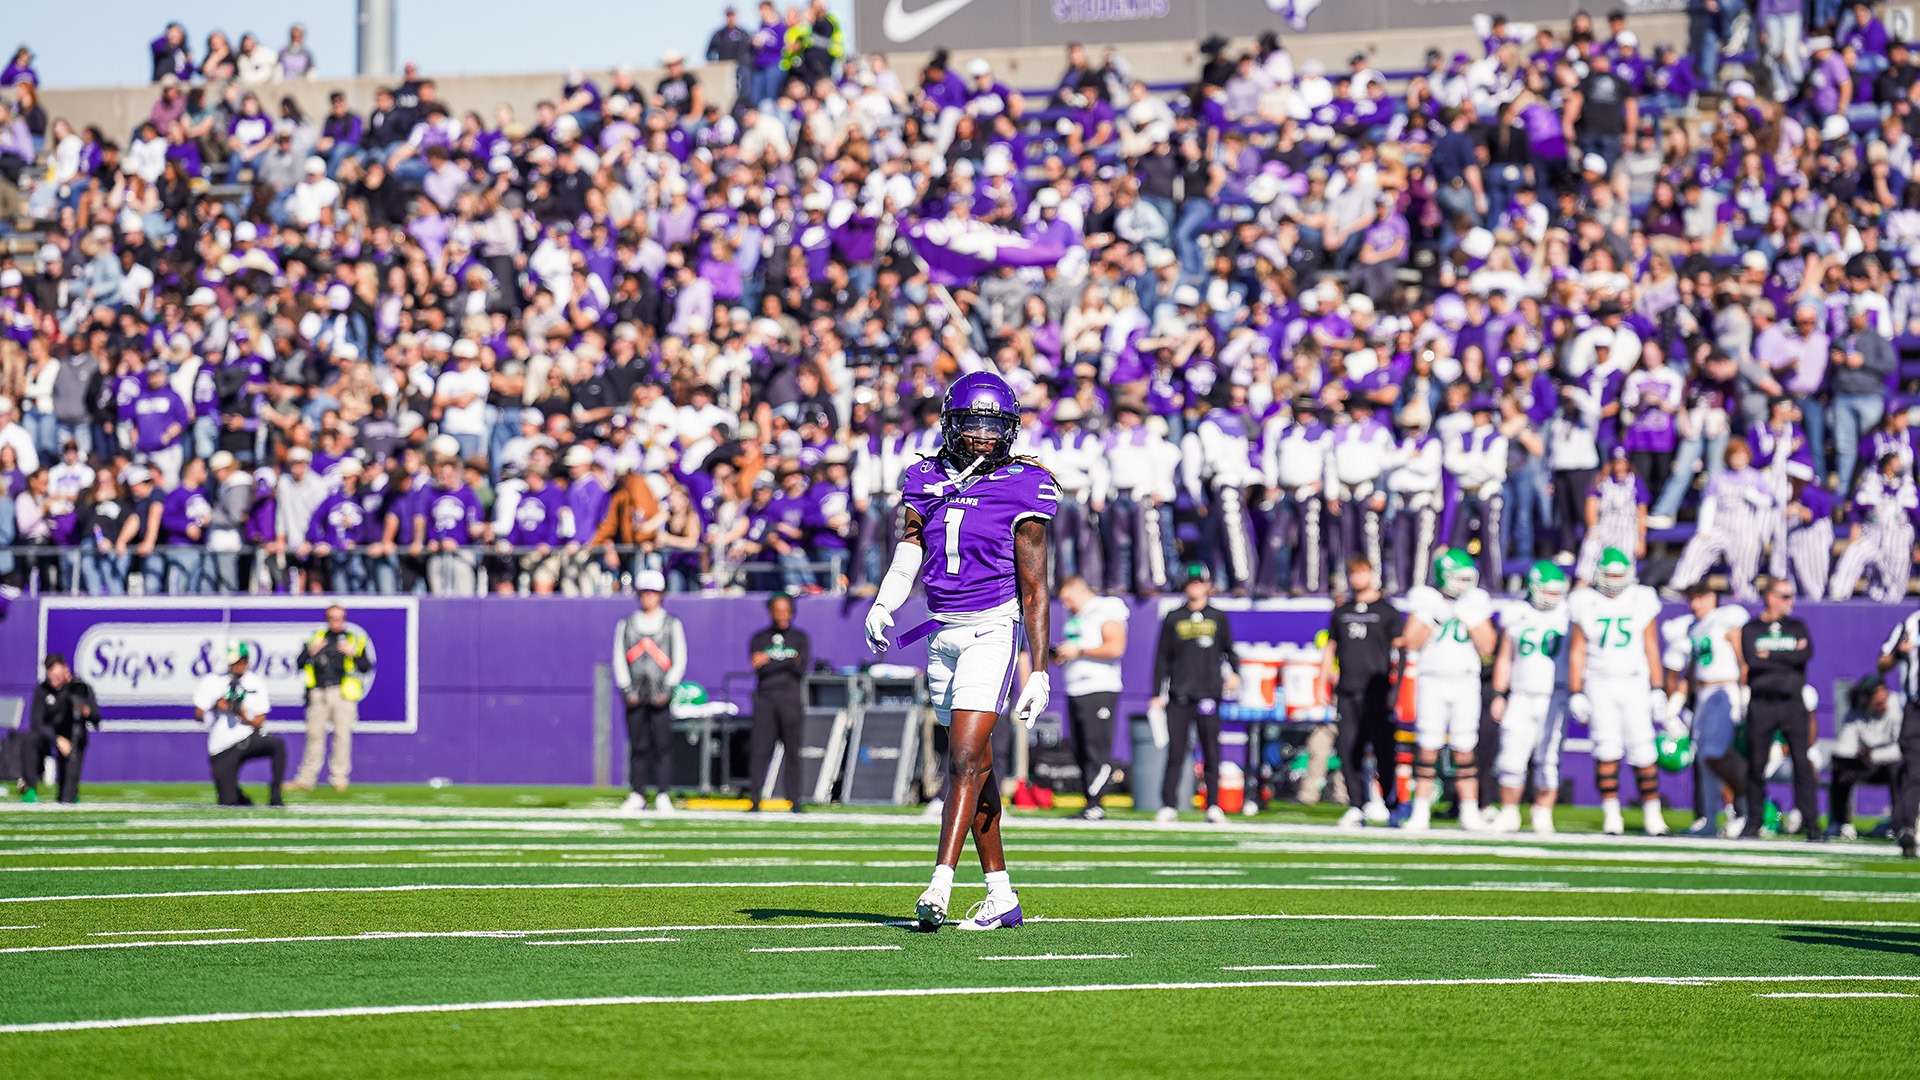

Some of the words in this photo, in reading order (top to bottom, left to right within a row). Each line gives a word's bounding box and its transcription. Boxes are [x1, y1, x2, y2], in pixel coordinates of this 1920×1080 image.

[943, 496, 979, 507] TEXANS
[942, 507, 967, 575] 1
[1519, 627, 1561, 657] 60
[1597, 616, 1633, 649] 75
